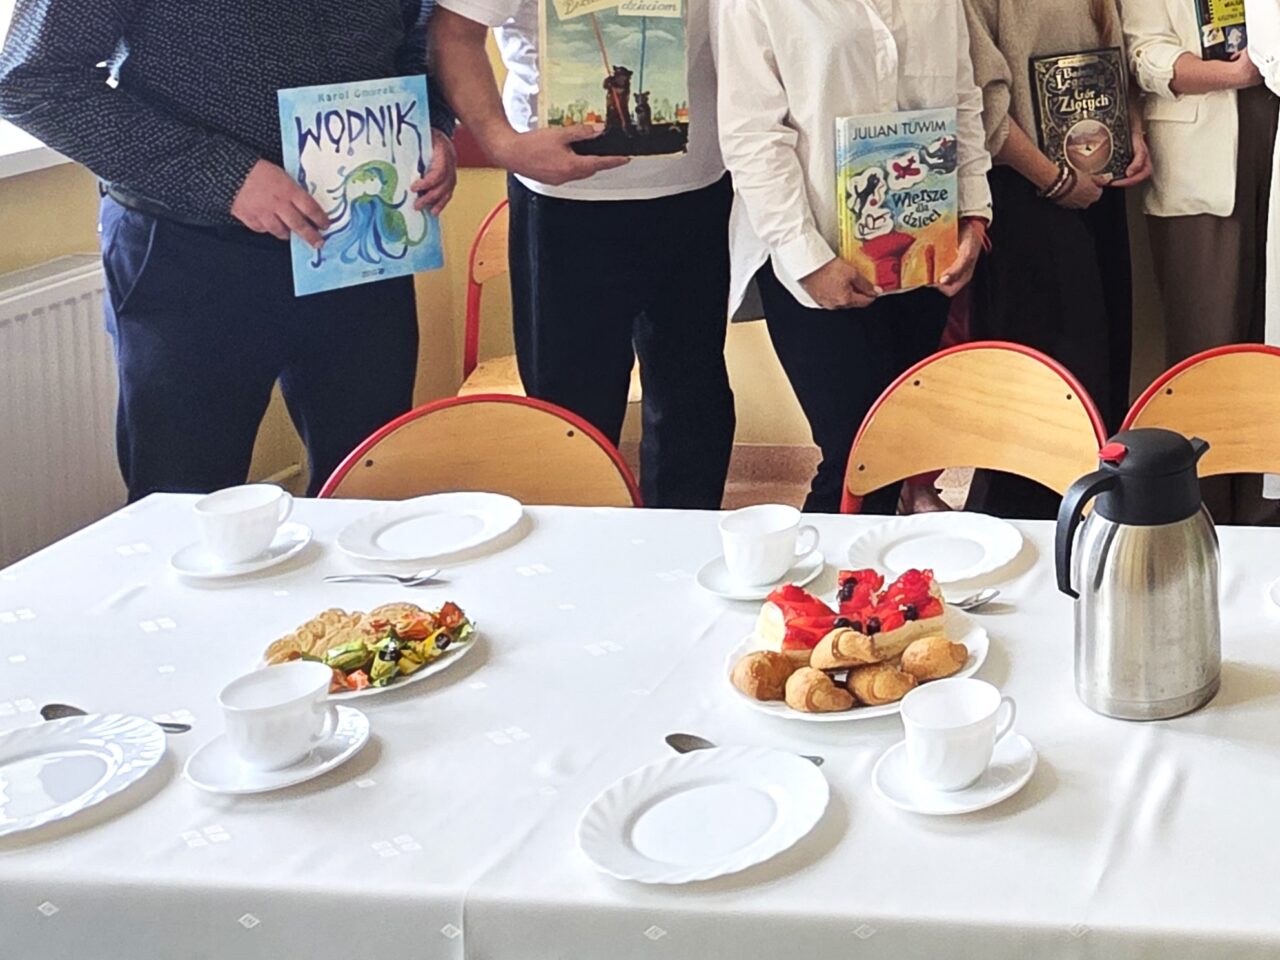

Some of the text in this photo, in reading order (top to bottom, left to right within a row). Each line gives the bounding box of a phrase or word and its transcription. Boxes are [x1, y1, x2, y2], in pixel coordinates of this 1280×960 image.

[622, 0, 677, 12] dzieciom
[317, 90, 349, 103] Karol
[295, 100, 420, 156] WODNIK
[852, 121, 947, 141] JULIAN TUWIM
[915, 203, 930, 213] dla
[902, 208, 943, 228] dzieci
